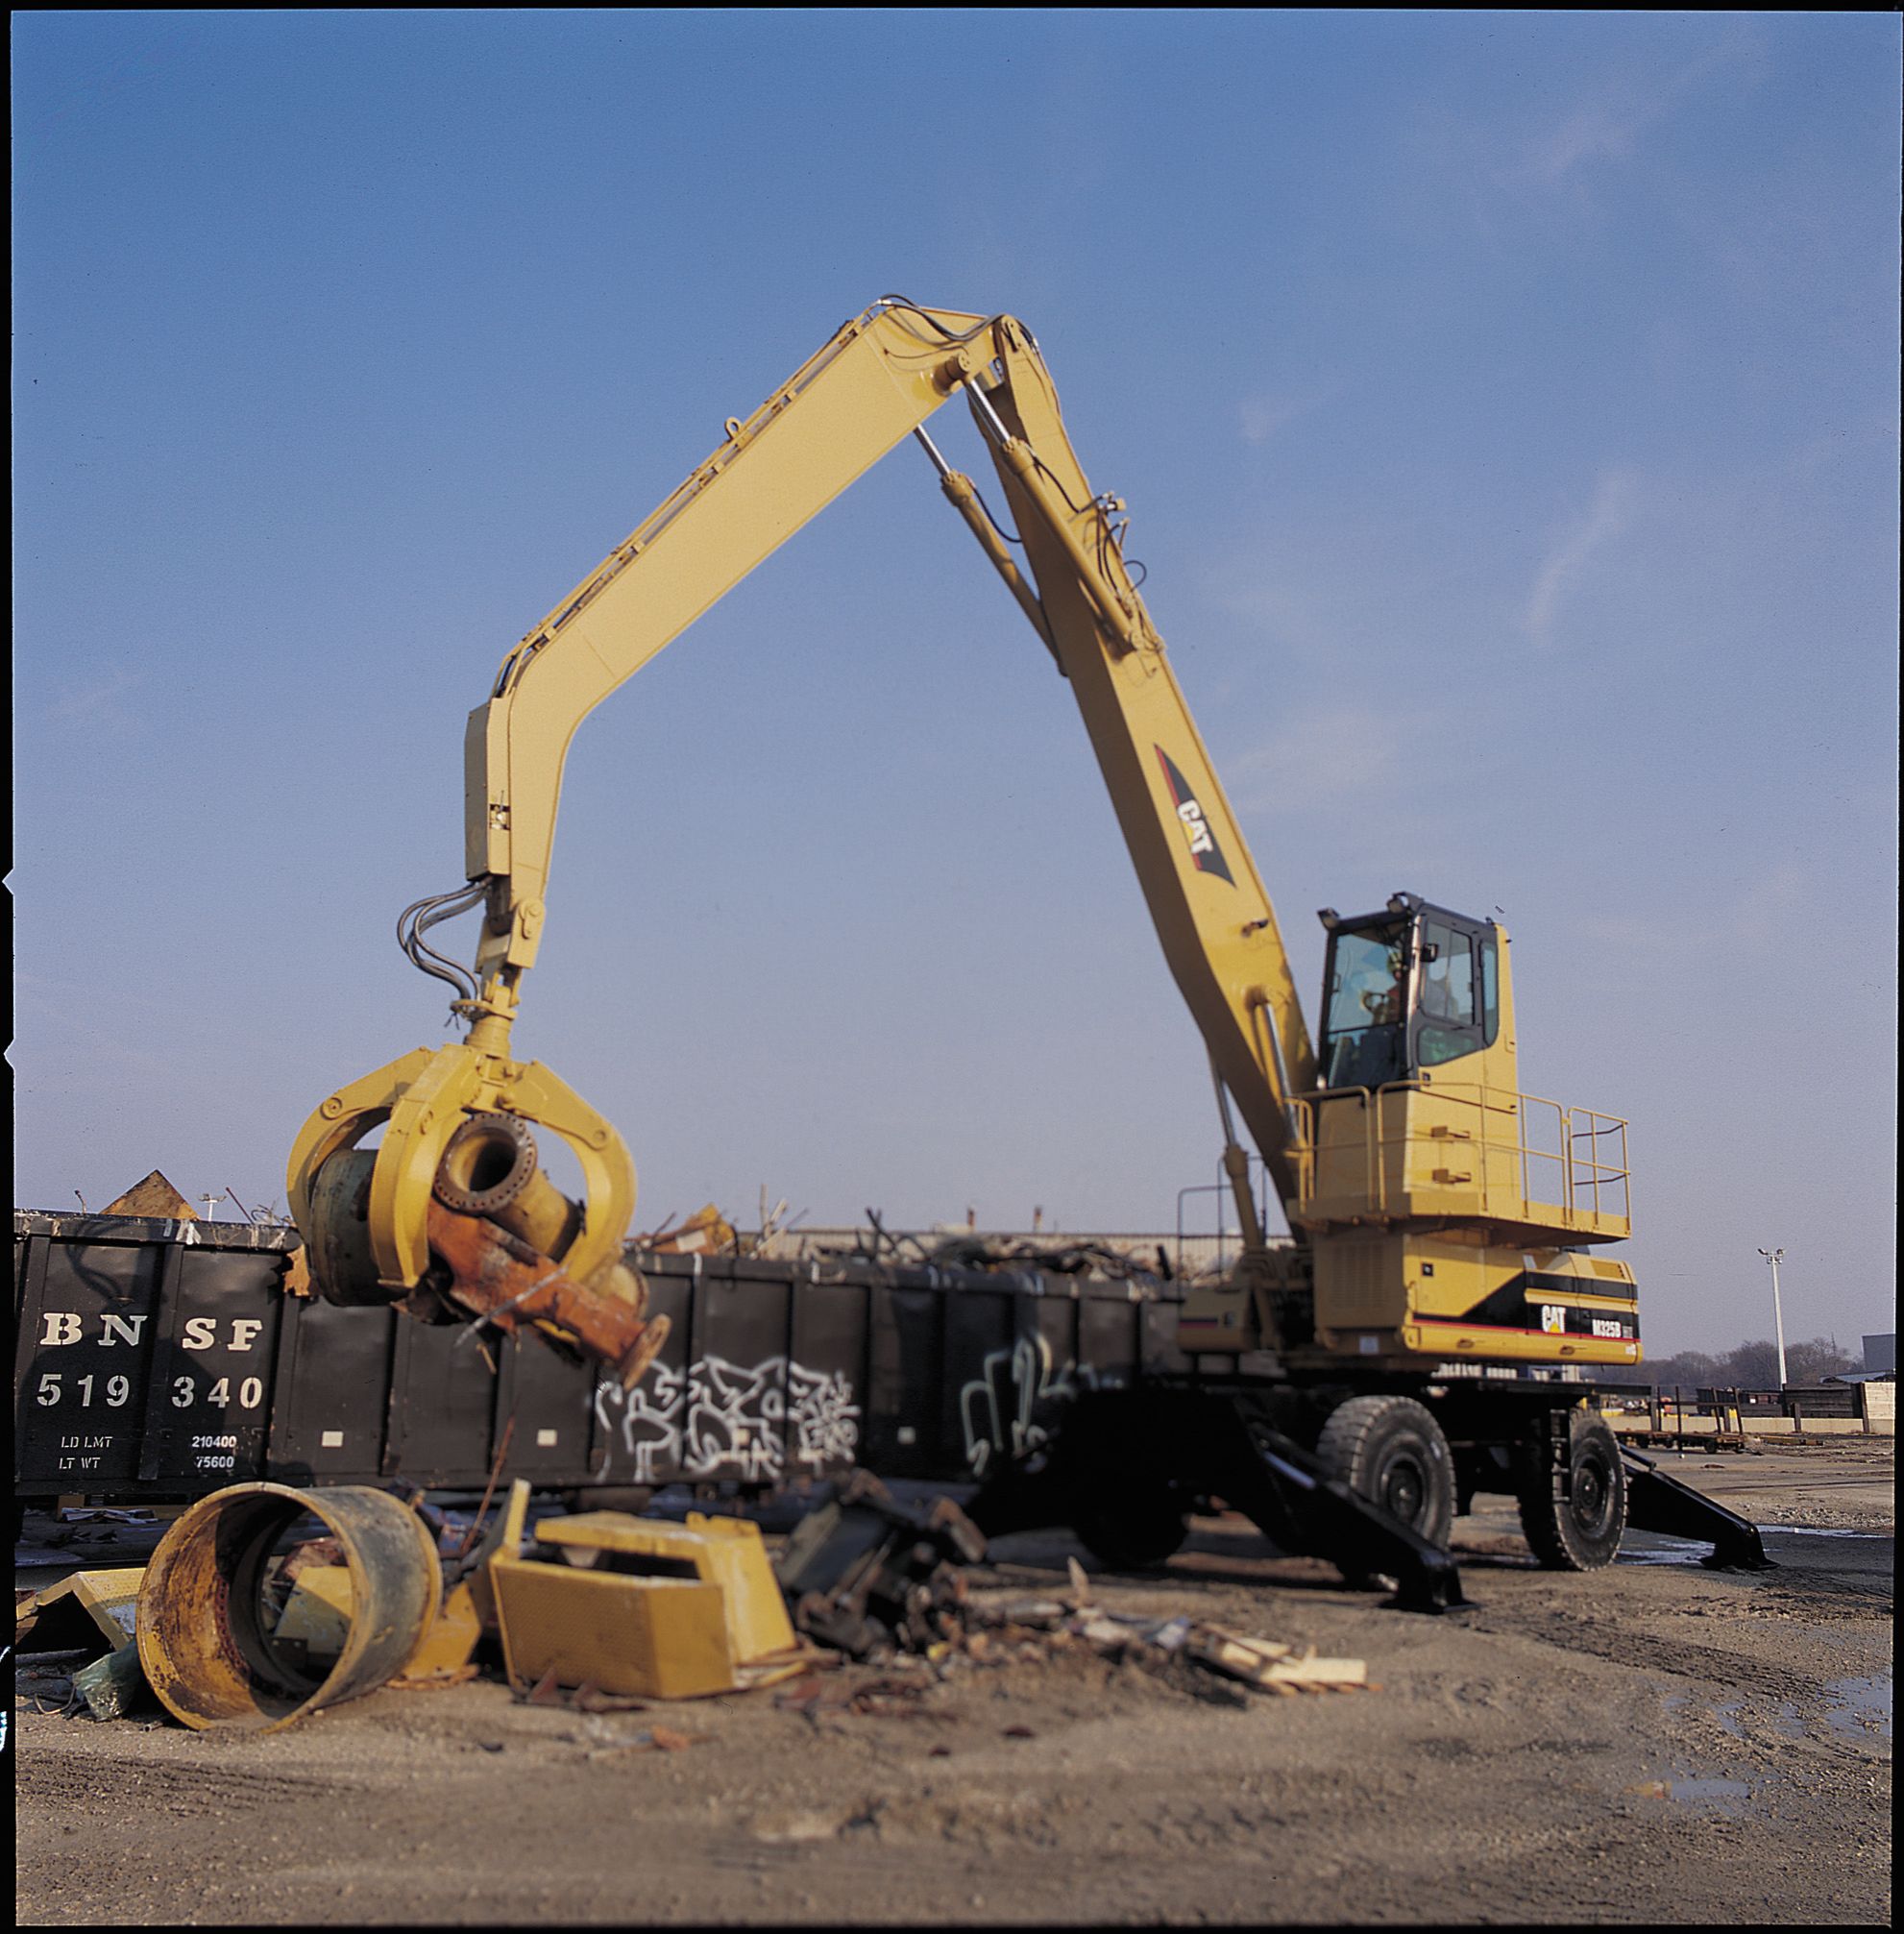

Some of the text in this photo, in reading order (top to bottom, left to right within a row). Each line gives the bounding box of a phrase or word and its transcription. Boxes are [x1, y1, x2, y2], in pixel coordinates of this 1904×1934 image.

[1177, 799, 1213, 854] CAT
[1542, 1305, 1566, 1334] CAT
[1592, 1319, 1622, 1337] M325B
[37, 1374, 262, 1408] 519 340
[61, 1435, 236, 1448] LD LMT 210400
[59, 1456, 234, 1469] LT WT 75600
